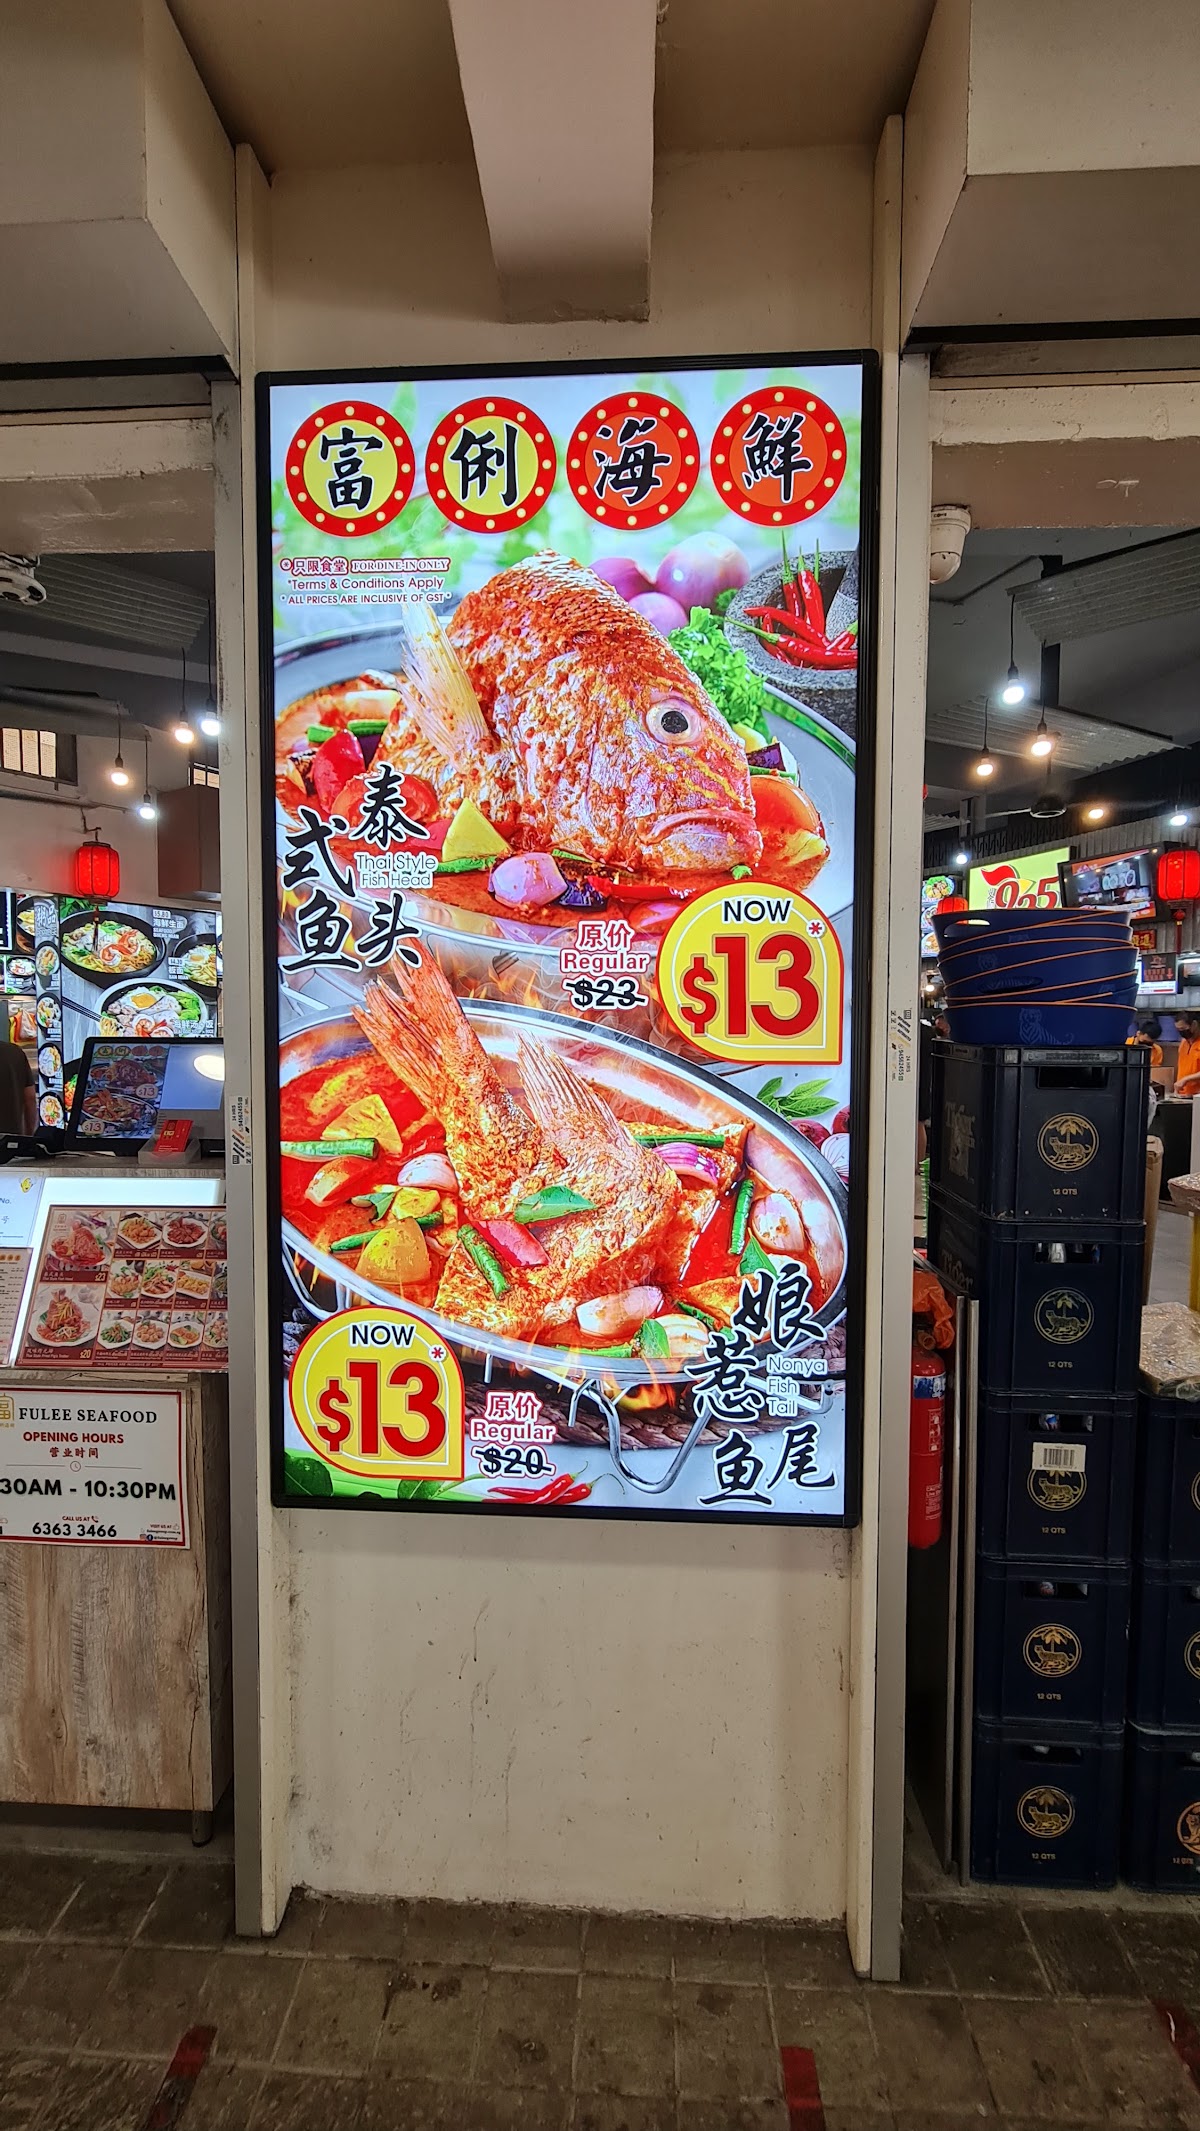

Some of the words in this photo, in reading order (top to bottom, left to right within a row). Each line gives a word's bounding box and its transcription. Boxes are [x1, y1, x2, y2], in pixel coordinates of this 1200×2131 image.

[293, 558, 347, 575] 只限食堂
[352, 560, 374, 572] FOR
[374, 560, 418, 572] DINE-IN
[418, 559, 449, 571] ONLY
[330, 578, 338, 590] &
[341, 577, 405, 590] Conditions
[408, 576, 444, 590] Apply
[288, 595, 304, 605] ALL
[306, 595, 339, 604] PRICES
[340, 594, 358, 604] ARE
[360, 594, 409, 603] INCLUSIVE
[410, 593, 424, 602] OF
[426, 593, 444, 602] GST
[357, 855, 392, 869] Thai
[394, 854, 436, 874] Style
[362, 874, 386, 886] Fish
[391, 873, 431, 887] Head
[723, 900, 791, 922] NOW
[578, 922, 634, 949] 原价
[563, 952, 648, 975] Regular
[573, 978, 637, 1007] $23
[680, 933, 819, 1036] $13
[1062, 1188, 1078, 1196] QTS
[351, 1325, 415, 1346] NOW
[767, 1356, 826, 1375] Nonya
[1057, 1361, 1073, 1369] QTS
[767, 1379, 797, 1393] Fish
[317, 1361, 446, 1456] $13
[487, 1394, 540, 1419] 原价
[767, 1401, 797, 1415] Tail
[18, 1407, 72, 1421] FULEE
[77, 1409, 157, 1424] SEAFOOD
[23, 1431, 78, 1442] OPENING
[82, 1433, 124, 1444] HOURS
[473, 1421, 555, 1442] Regular
[50, 1446, 99, 1459] 营业时间
[482, 1447, 543, 1475] $20
[84, 1480, 176, 1501] 10:30PM
[32, 1522, 72, 1536] 6363
[77, 1523, 117, 1538] 3466
[1046, 1693, 1062, 1701] QTS
